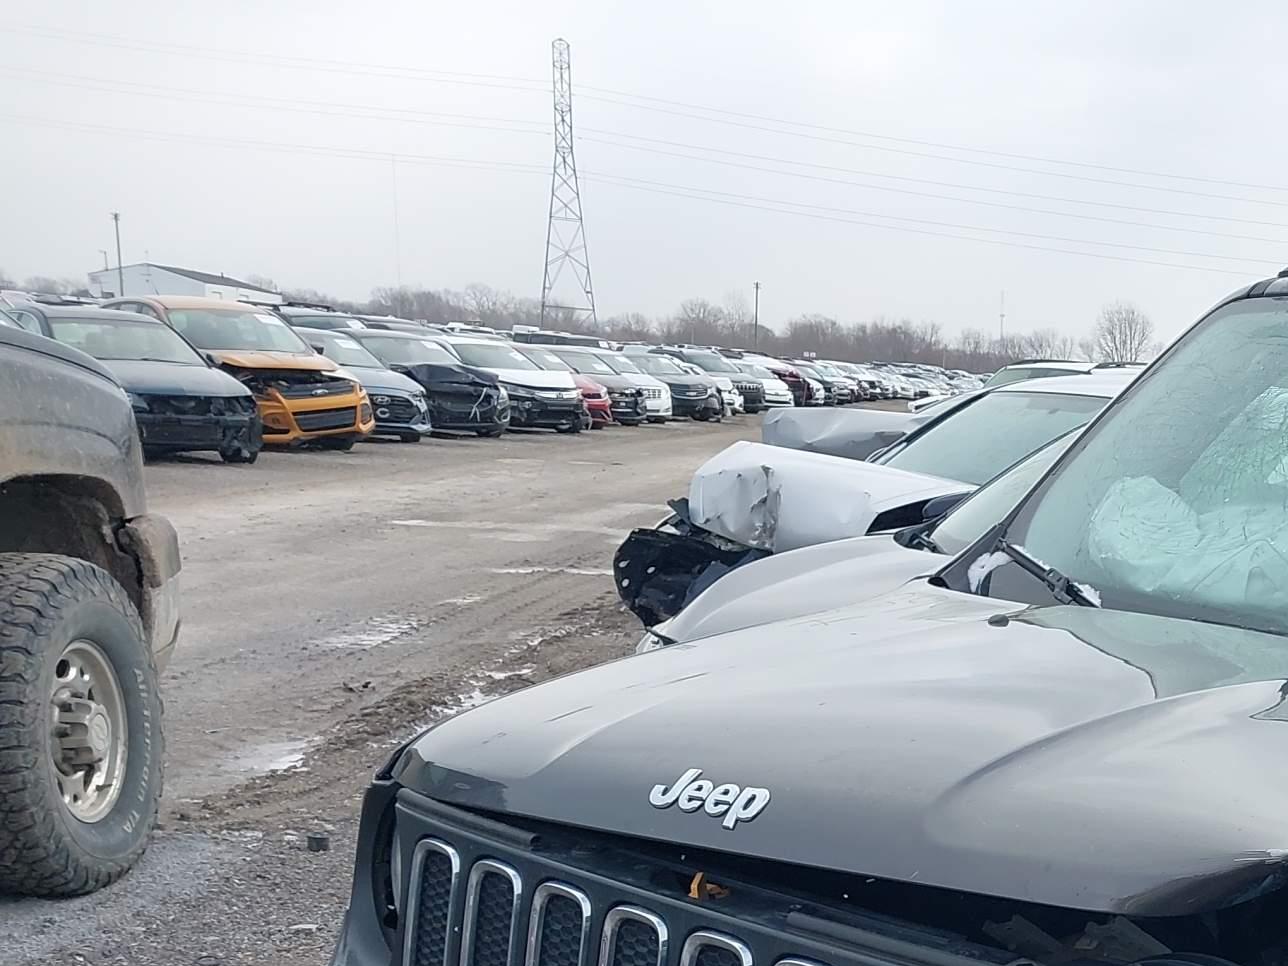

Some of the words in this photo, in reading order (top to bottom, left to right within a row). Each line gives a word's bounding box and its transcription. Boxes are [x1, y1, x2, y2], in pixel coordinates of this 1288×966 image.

[133, 667, 151, 801] All-Terrain
[122, 809, 141, 834] T/A
[649, 768, 771, 830] Jeep
